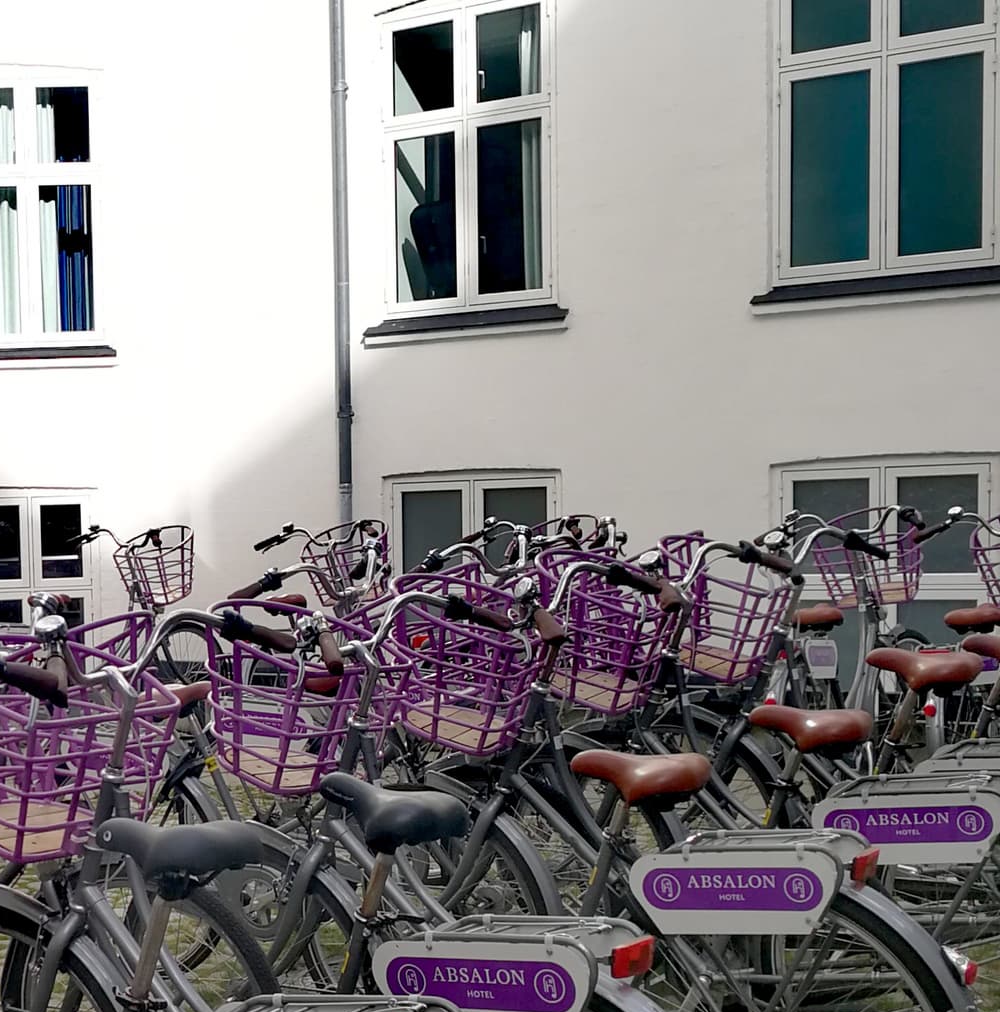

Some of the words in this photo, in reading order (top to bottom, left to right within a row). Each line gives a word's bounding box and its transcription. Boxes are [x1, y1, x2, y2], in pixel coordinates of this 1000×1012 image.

[865, 812, 949, 826] ABSALON
[687, 874, 776, 889] ABSALON
[719, 893, 744, 901] HOTEL
[433, 966, 525, 985] ABSALON
[467, 989, 495, 999] HOTEL
